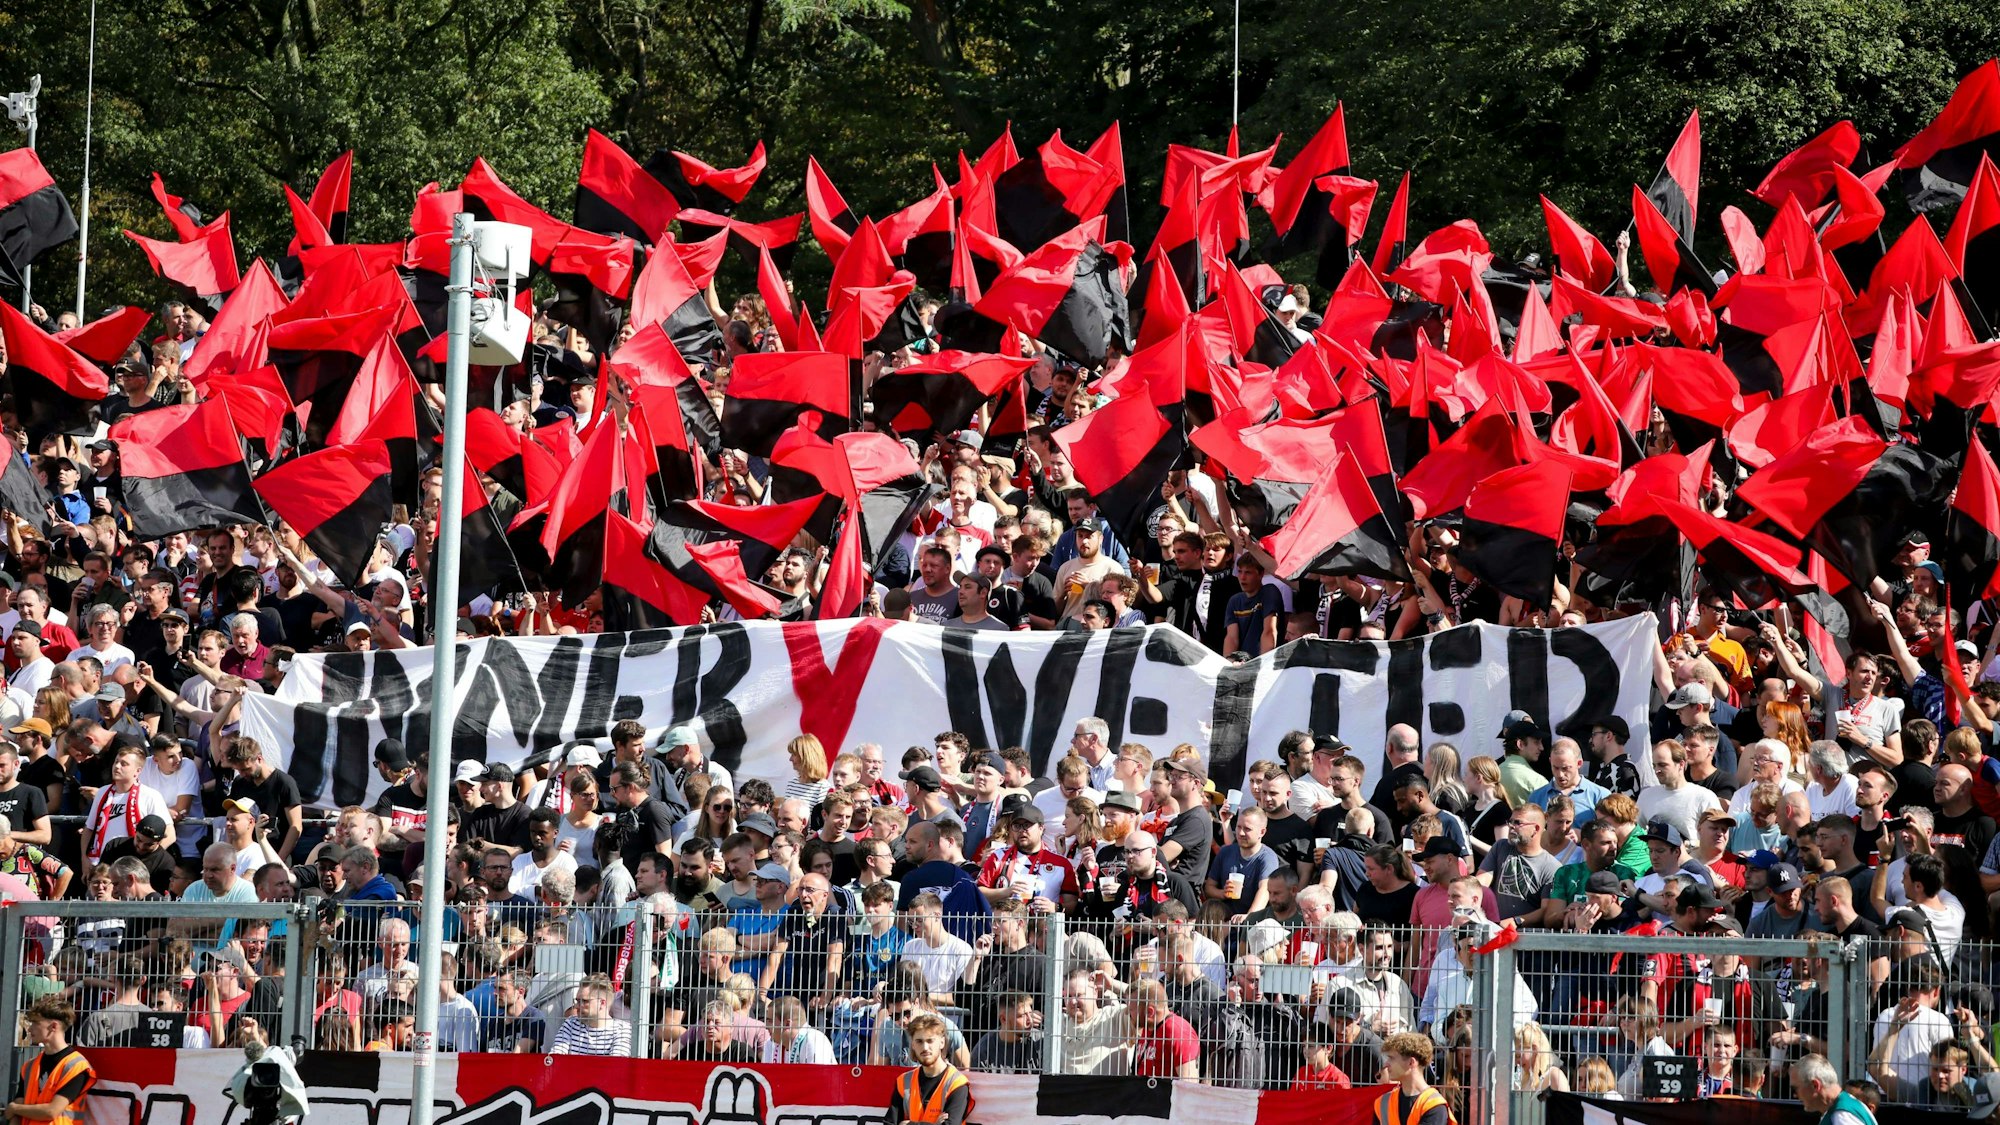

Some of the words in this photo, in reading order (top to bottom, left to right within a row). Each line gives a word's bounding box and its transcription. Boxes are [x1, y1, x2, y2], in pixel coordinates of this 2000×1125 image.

[940, 625, 1622, 792] WEITER
[148, 1017, 173, 1031] Tor
[151, 1033, 170, 1047] 38
[1654, 1061, 1684, 1076] Tor
[1660, 1079, 1682, 1094] 39
